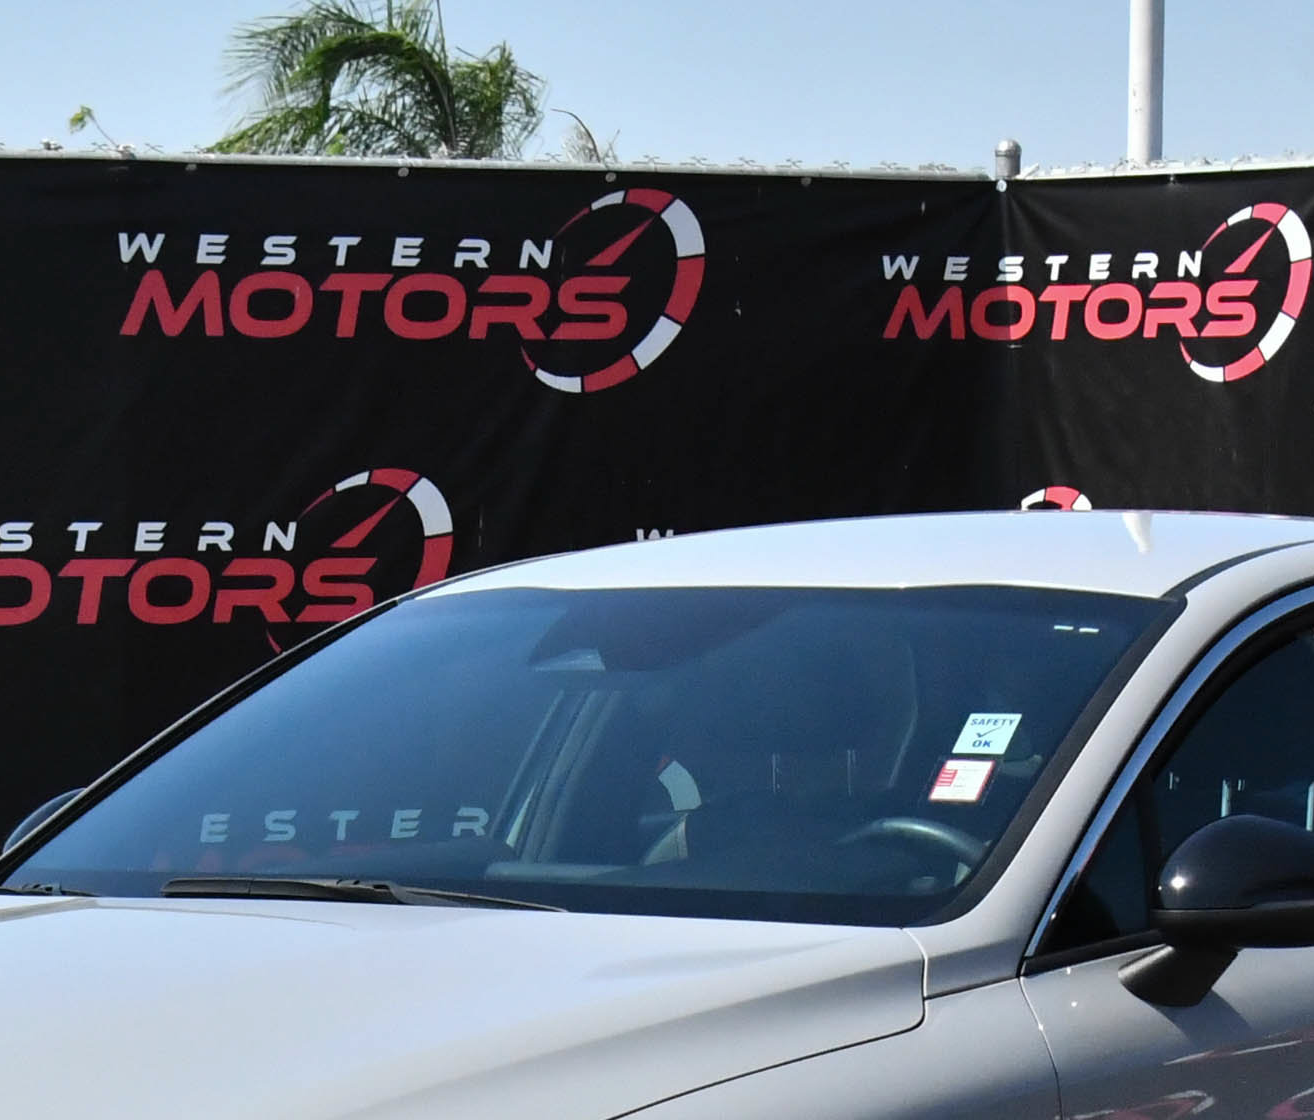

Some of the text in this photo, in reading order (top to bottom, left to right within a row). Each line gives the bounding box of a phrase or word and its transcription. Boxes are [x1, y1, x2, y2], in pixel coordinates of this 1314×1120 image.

[119, 232, 552, 268] WESTERN
[882, 250, 1202, 282] WESTERN
[121, 270, 630, 339] MOTORS
[883, 279, 1259, 340] MOTORS
[970, 718, 1016, 727] SAFETY
[972, 739, 992, 748] OK
